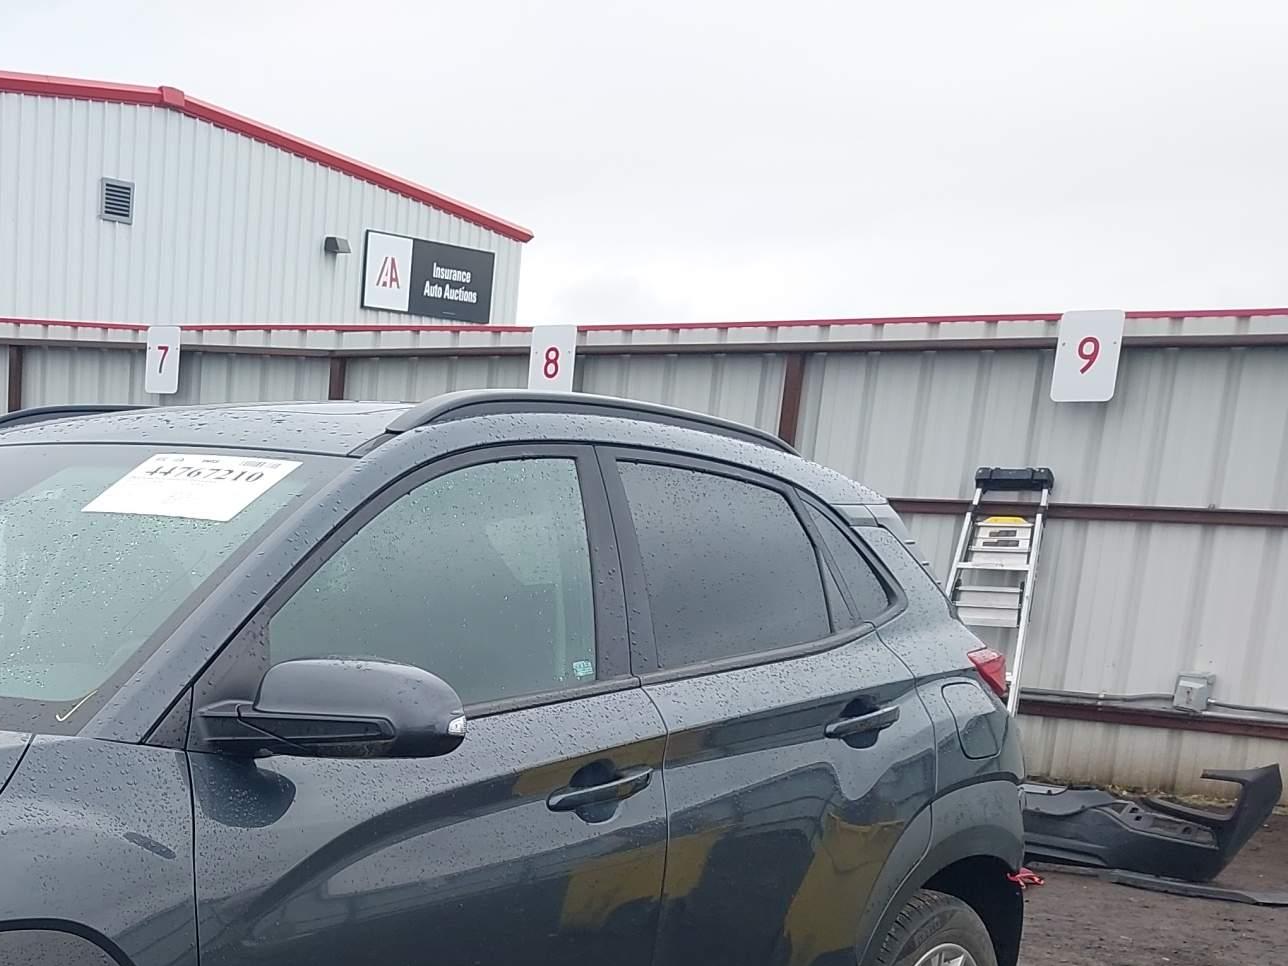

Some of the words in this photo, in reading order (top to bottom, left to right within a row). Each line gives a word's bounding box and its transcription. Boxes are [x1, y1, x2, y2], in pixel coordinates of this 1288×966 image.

[432, 261, 472, 284] Insurance
[423, 280, 443, 298] Auto
[443, 282, 478, 304] Auctions
[157, 345, 169, 374] 7
[543, 346, 560, 379] 8
[1078, 336, 1100, 375] 9
[144, 465, 265, 483] 44767210
